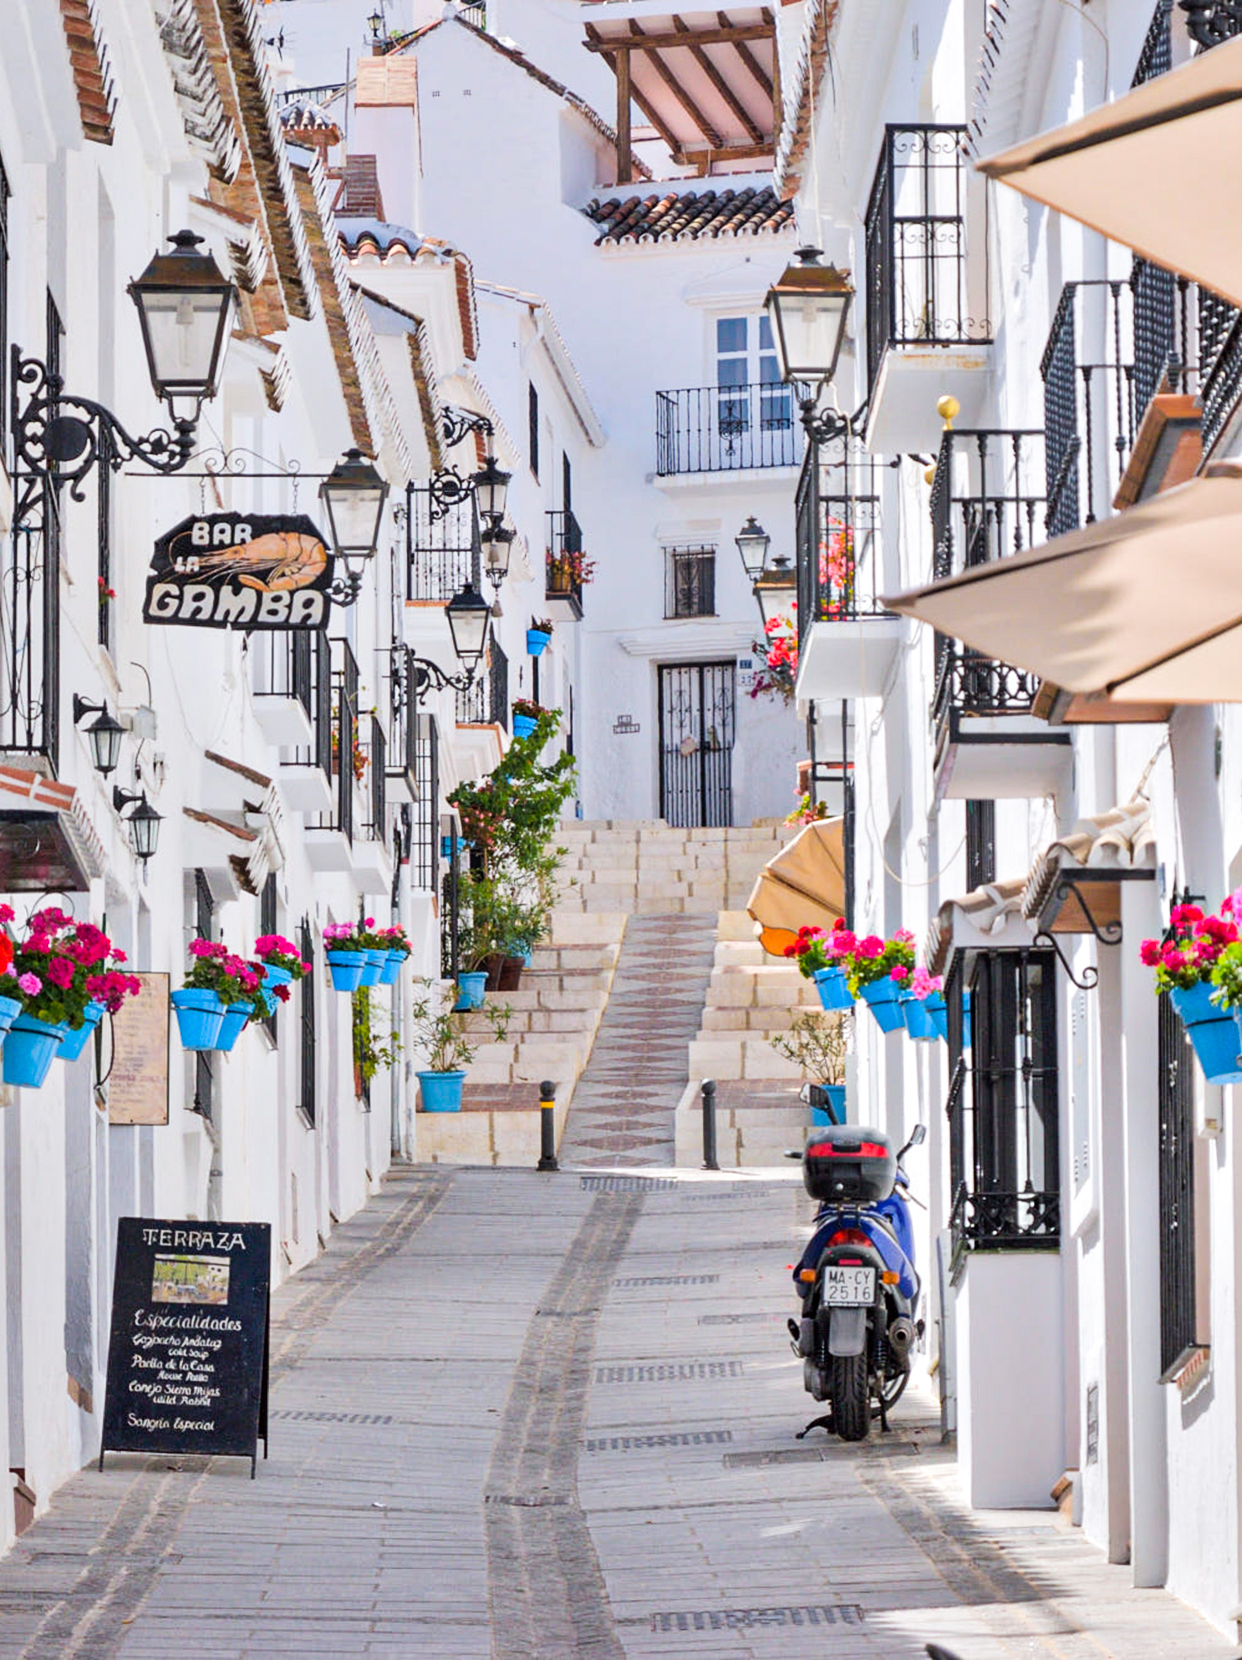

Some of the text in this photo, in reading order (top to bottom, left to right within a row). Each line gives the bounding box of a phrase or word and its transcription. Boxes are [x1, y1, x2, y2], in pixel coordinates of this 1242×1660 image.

[191, 521, 252, 546] BAR
[174, 556, 200, 573] LA
[148, 583, 325, 625] GAMBA
[142, 1228, 247, 1251] TERRAZA
[829, 1285, 871, 1301] 2516
[134, 1308, 243, 1332] Especialidades
[165, 1358, 177, 1369] de
[179, 1358, 190, 1371] la
[190, 1360, 215, 1373] Casa
[128, 1379, 163, 1397] Conejo
[164, 1384, 192, 1395] Sierra
[173, 1417, 215, 1432] Especial
